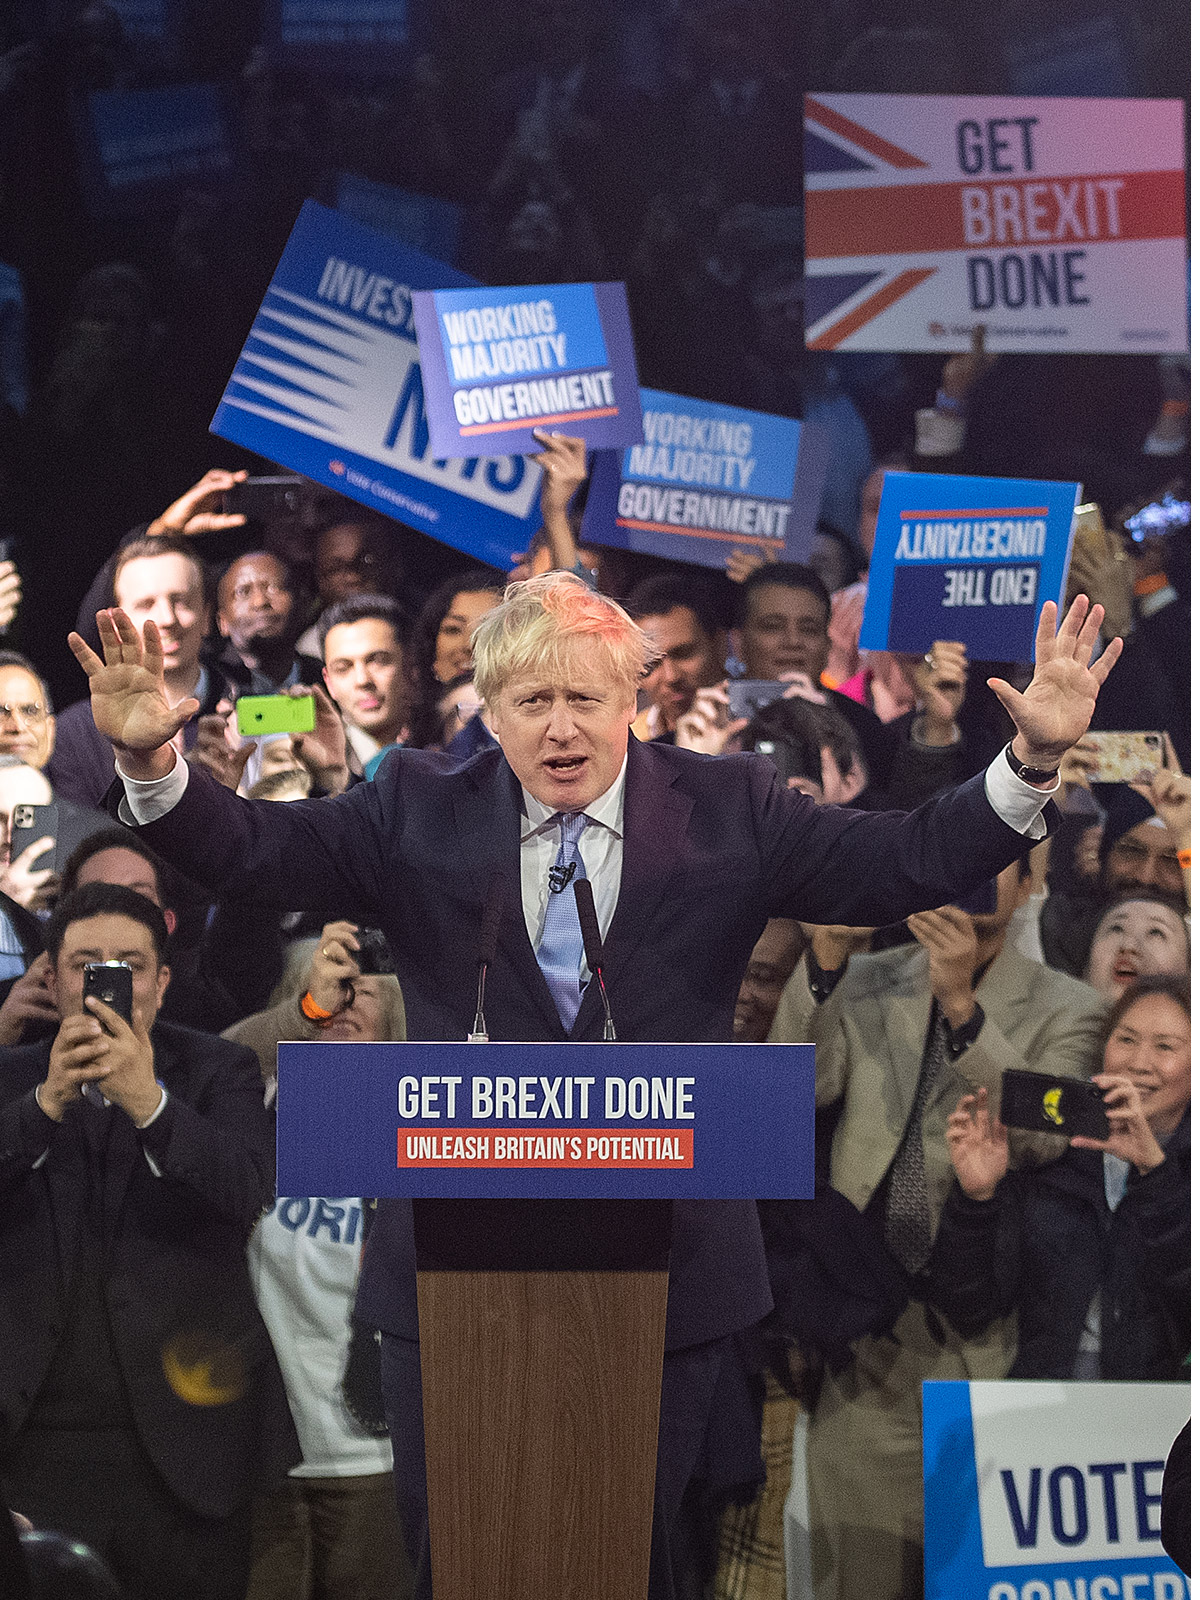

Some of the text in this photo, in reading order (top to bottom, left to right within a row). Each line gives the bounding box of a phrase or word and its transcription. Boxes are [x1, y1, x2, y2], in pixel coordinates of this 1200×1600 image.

[956, 116, 1039, 175] GET
[961, 179, 1125, 244] BREXIT
[317, 257, 415, 331] INVES
[967, 251, 1090, 311] DONE
[442, 299, 557, 345] WORKING
[451, 333, 566, 380] MAJORITY
[453, 371, 613, 426] GOVERNMENT
[629, 444, 756, 489] MAJORITY
[617, 483, 791, 538] GOVERNMENT
[895, 519, 1046, 560] UNCERTAINTY
[941, 568, 1037, 607] END THE
[398, 1076, 695, 1120] GET BREXIT DONE
[406, 1136, 684, 1160] UNLEASH BRITAIN'S POTENTIAL
[1000, 1460, 1164, 1550] VOTE
